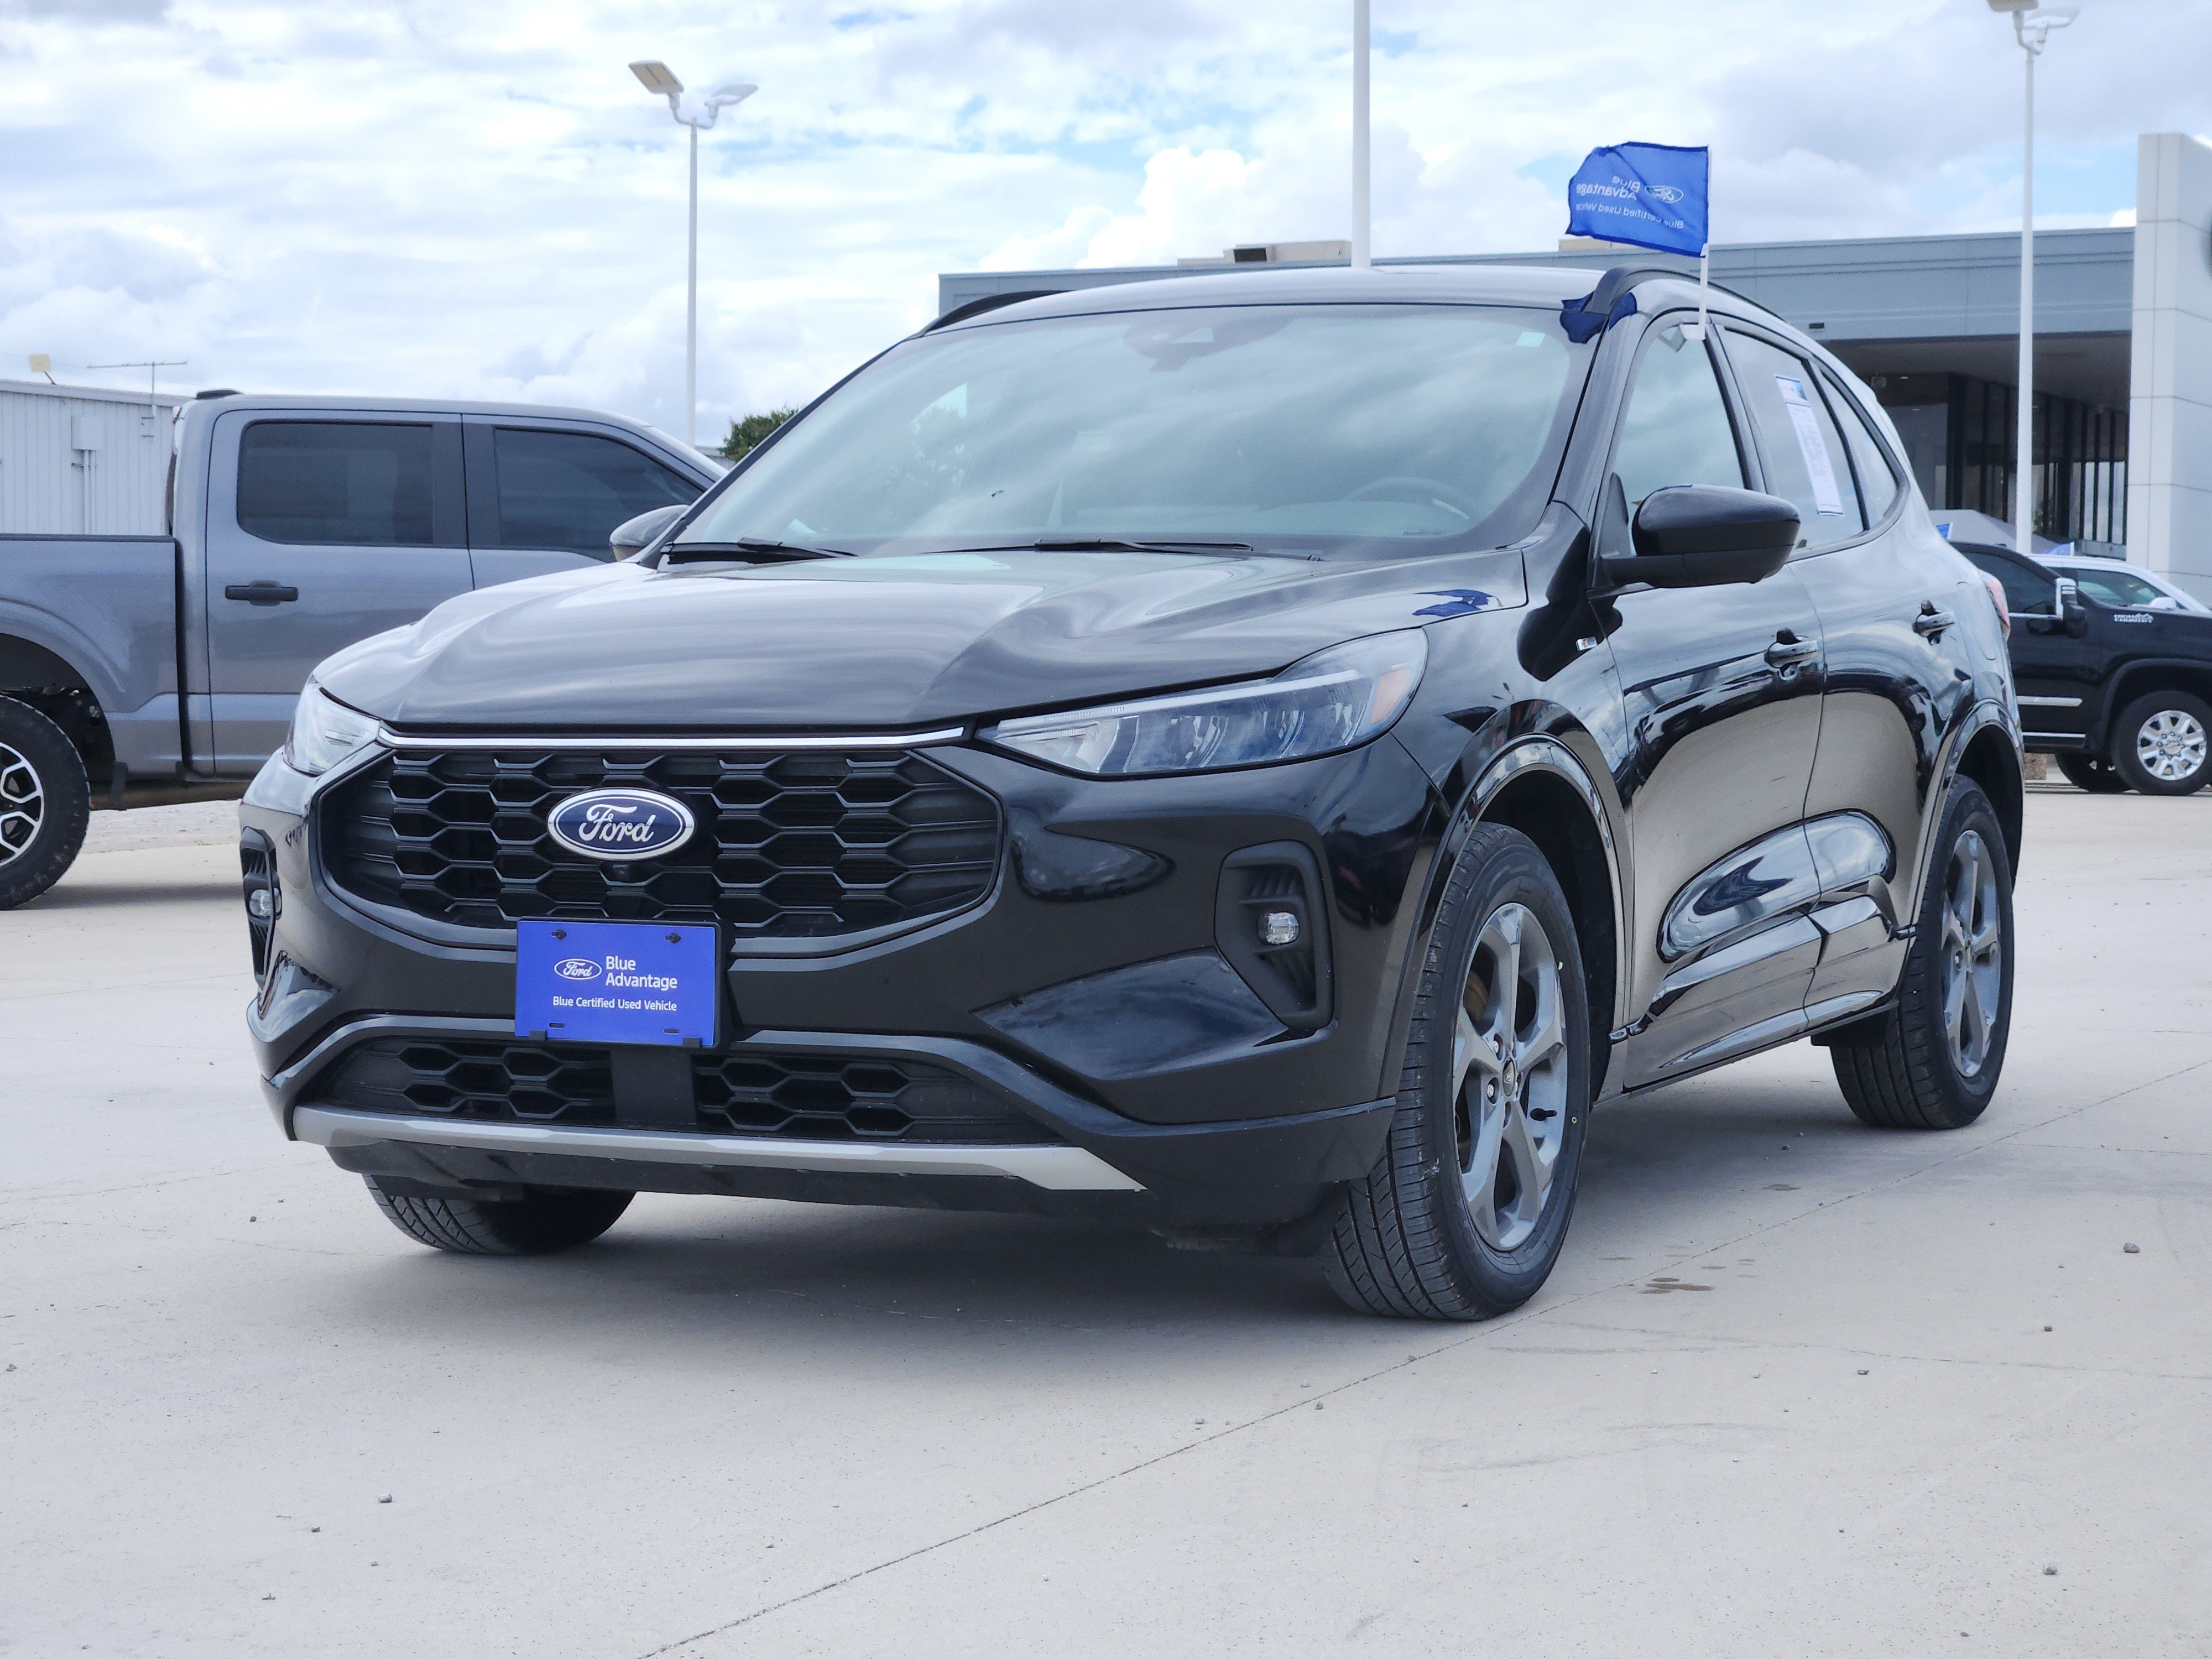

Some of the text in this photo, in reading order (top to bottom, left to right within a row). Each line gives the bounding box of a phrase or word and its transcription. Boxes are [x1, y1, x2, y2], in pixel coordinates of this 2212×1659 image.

[578, 804, 656, 842] Ford
[563, 961, 593, 977] Ford
[606, 956, 636, 971] Blue
[605, 972, 677, 991] Advantage
[552, 996, 677, 1011] Blue Certified Used Vehicle
